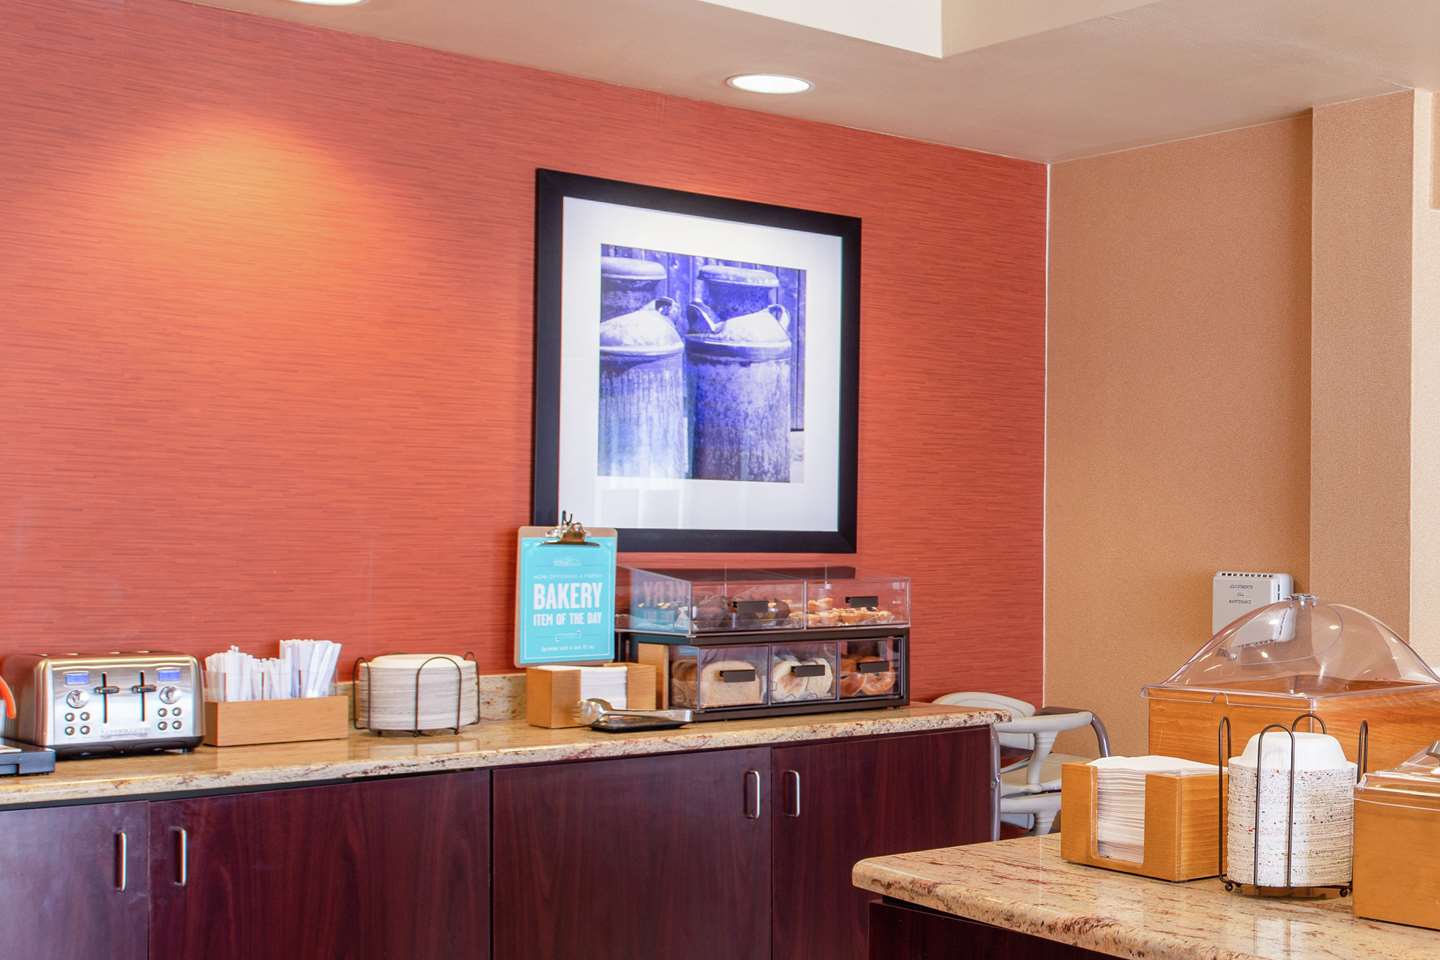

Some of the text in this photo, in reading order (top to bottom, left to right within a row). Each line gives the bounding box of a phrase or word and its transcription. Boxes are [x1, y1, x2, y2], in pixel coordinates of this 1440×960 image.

[533, 582, 603, 610] BAKERY
[533, 611, 602, 627] ITEM OF THE DAY
